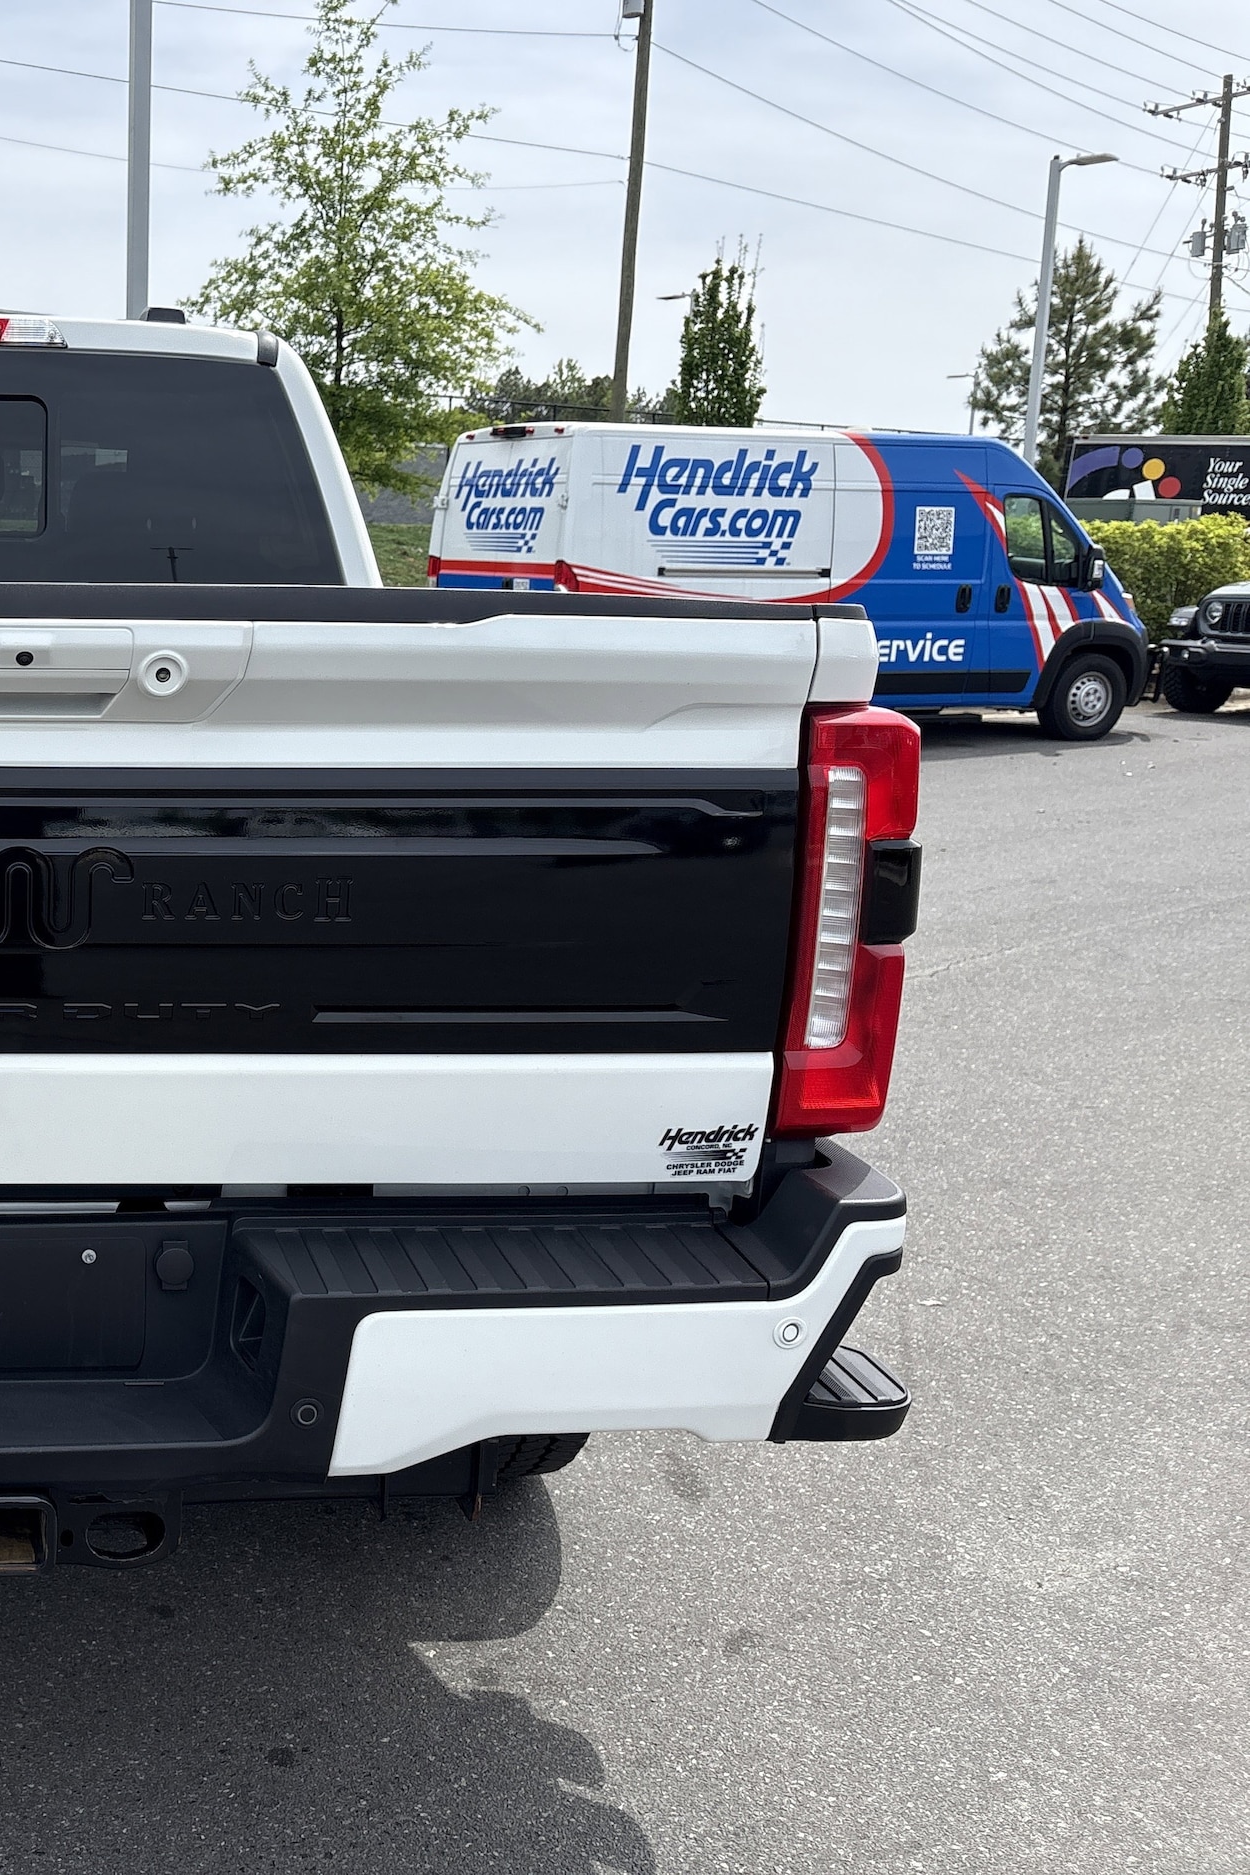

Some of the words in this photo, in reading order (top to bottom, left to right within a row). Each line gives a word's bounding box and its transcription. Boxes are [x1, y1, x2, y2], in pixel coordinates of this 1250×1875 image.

[617, 444, 819, 511] Hendrick
[1207, 457, 1244, 474] Your
[455, 457, 560, 512] Hendrick
[1202, 472, 1249, 493] Single
[466, 500, 545, 531] Cars.com
[649, 498, 801, 538] Cars.com
[140, 876, 355, 923] RANCH
[62, 1002, 281, 1021] DUTY
[658, 1123, 759, 1151] Hendrick
[666, 1162, 712, 1170] CHRYSLER
[714, 1160, 745, 1168] DODGE
[671, 1169, 694, 1177] JEEP
